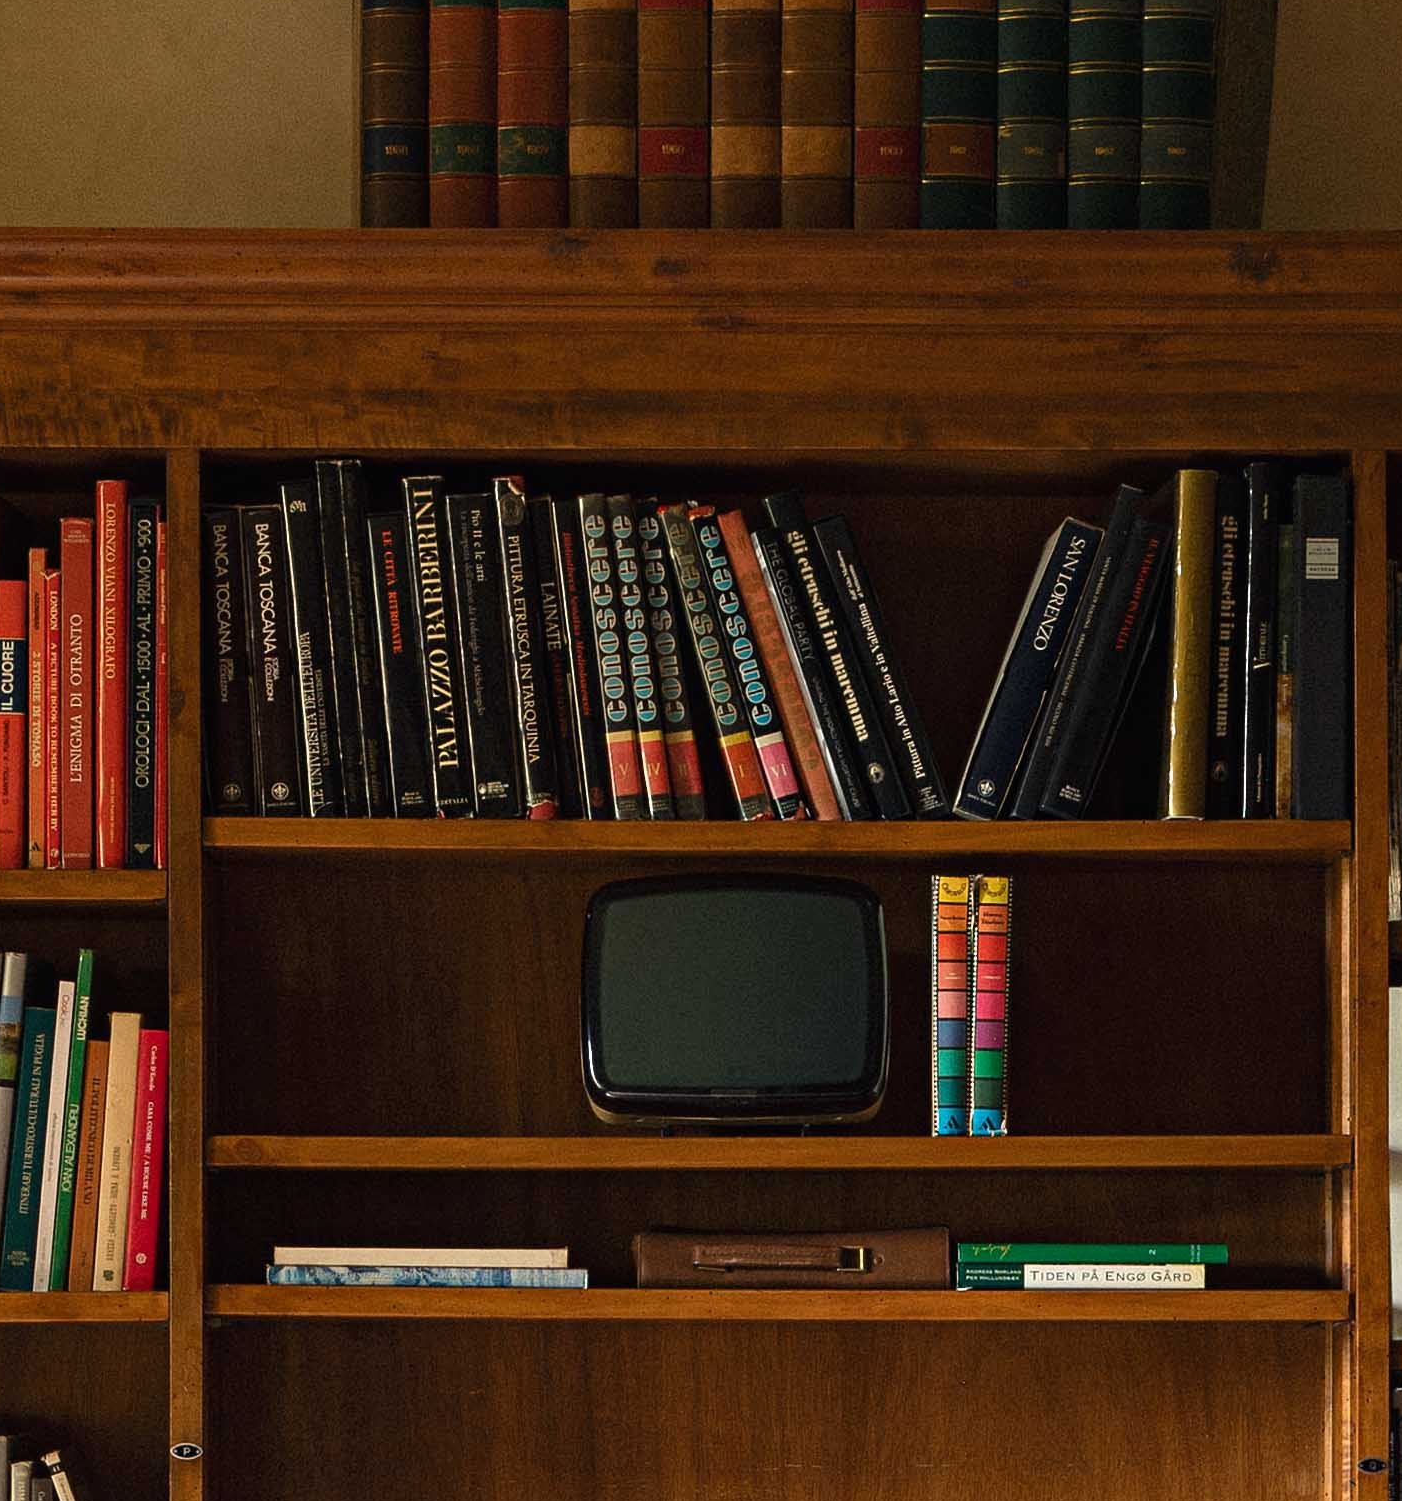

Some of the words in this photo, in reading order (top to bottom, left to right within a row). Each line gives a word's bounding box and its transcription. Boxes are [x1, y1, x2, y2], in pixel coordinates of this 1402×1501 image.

[104, 503, 116, 563] LORENZO
[213, 524, 231, 576] BANCA
[254, 523, 272, 576] BANCA
[766, 542, 785, 566] THE
[784, 530, 806, 552] gli
[1061, 536, 1087, 571] SAN
[1222, 515, 1238, 539] gli
[104, 565, 116, 603] VIANI
[413, 488, 447, 641] BARBERINI
[507, 535, 524, 595] PITTURA
[774, 569, 802, 621] GLOBAL
[795, 556, 835, 628] etruschi
[1220, 543, 1237, 617] etruschi
[216, 583, 233, 655] TOSCANA
[259, 581, 277, 653] TOSCANA
[513, 597, 529, 659] ETRUSCA
[540, 582, 562, 651] LAINATE
[584, 514, 628, 722] conoscere
[611, 514, 658, 722] conoscere
[638, 517, 685, 724] conoscere
[667, 523, 737, 726] conoscere
[700, 525, 773, 726] conoscere
[792, 622, 816, 661] PARTY
[822, 631, 841, 650] in
[1033, 570, 1073, 651] LORENZO
[1220, 623, 1233, 640] in
[1, 641, 14, 693] CUORE
[70, 614, 83, 685] OTRANTO
[104, 605, 116, 679] XILOGRAFO
[518, 663, 532, 680] IN
[1, 697, 13, 710] IL
[70, 692, 83, 707] DI
[427, 649, 460, 768] PALAZZO
[521, 683, 541, 764] TARQUINIA
[830, 653, 872, 742] maremma
[1215, 646, 1231, 739] maremma
[70, 716, 83, 782] L'ENIGMA
[76, 997, 89, 1041] LUCHIAN
[63, 1104, 80, 1167] ALEXANDRU
[62, 1167, 74, 1193] IOAN
[1030, 1270, 1074, 1282] TIDEN
[1082, 1268, 1099, 1282] PÅ
[1151, 1268, 1192, 1283] GÅRD
